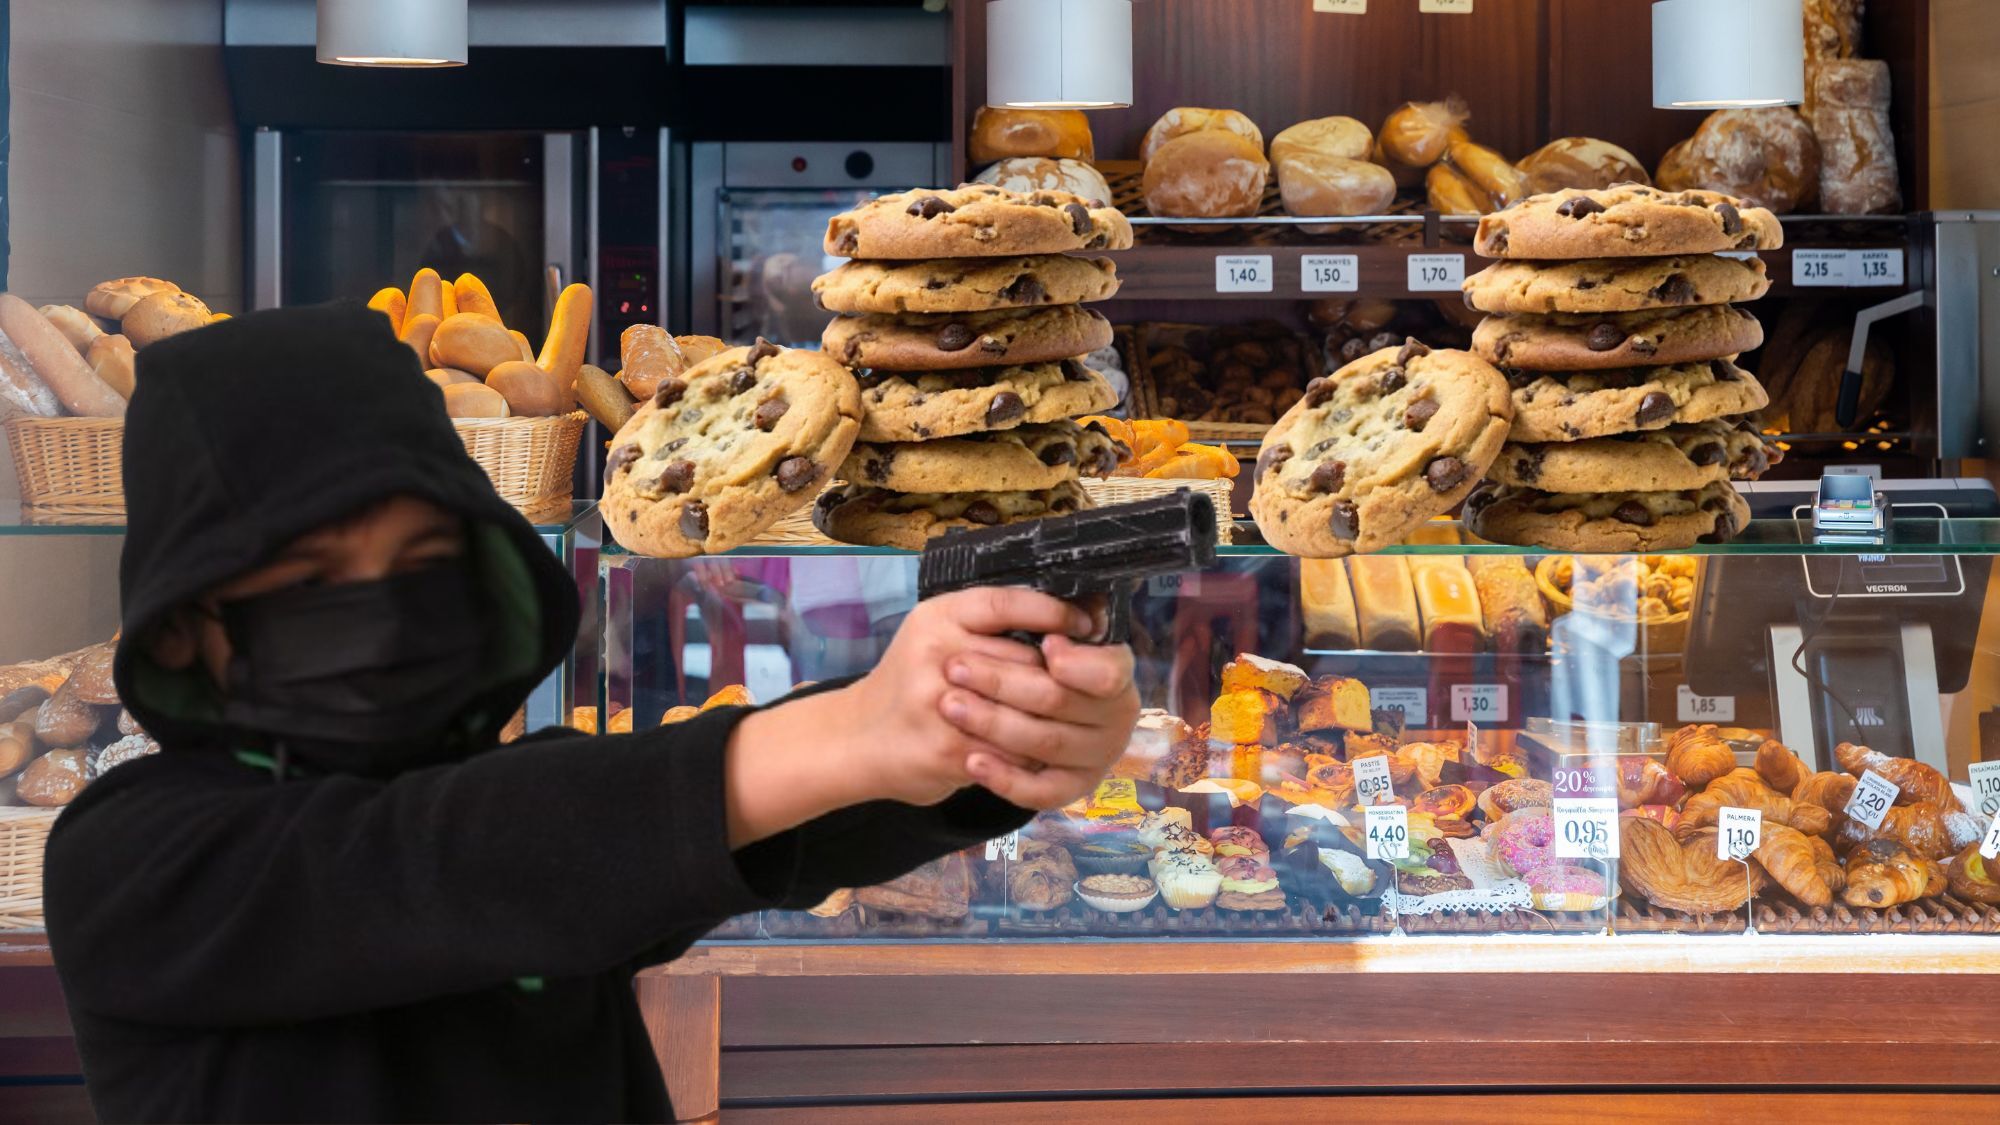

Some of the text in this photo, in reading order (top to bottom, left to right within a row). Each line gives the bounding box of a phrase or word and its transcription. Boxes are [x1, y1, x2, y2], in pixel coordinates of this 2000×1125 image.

[1229, 268, 1257, 285] 1,40
[1314, 268, 1341, 285] 1,50
[1421, 267, 1447, 284] 1,70
[1804, 261, 1829, 278] 2,15
[1862, 262, 1888, 279] 1,35
[1866, 584, 1908, 593] VECTRON
[1462, 696, 1489, 713] 1,30
[1690, 698, 1717, 716] 1,85
[1977, 776, 2000, 798] 1,10
[1856, 786, 1886, 812] 1,20
[1726, 813, 1756, 822] PALMERA
[1564, 820, 1609, 847] 0,95
[1726, 827, 1755, 848] 1,10
